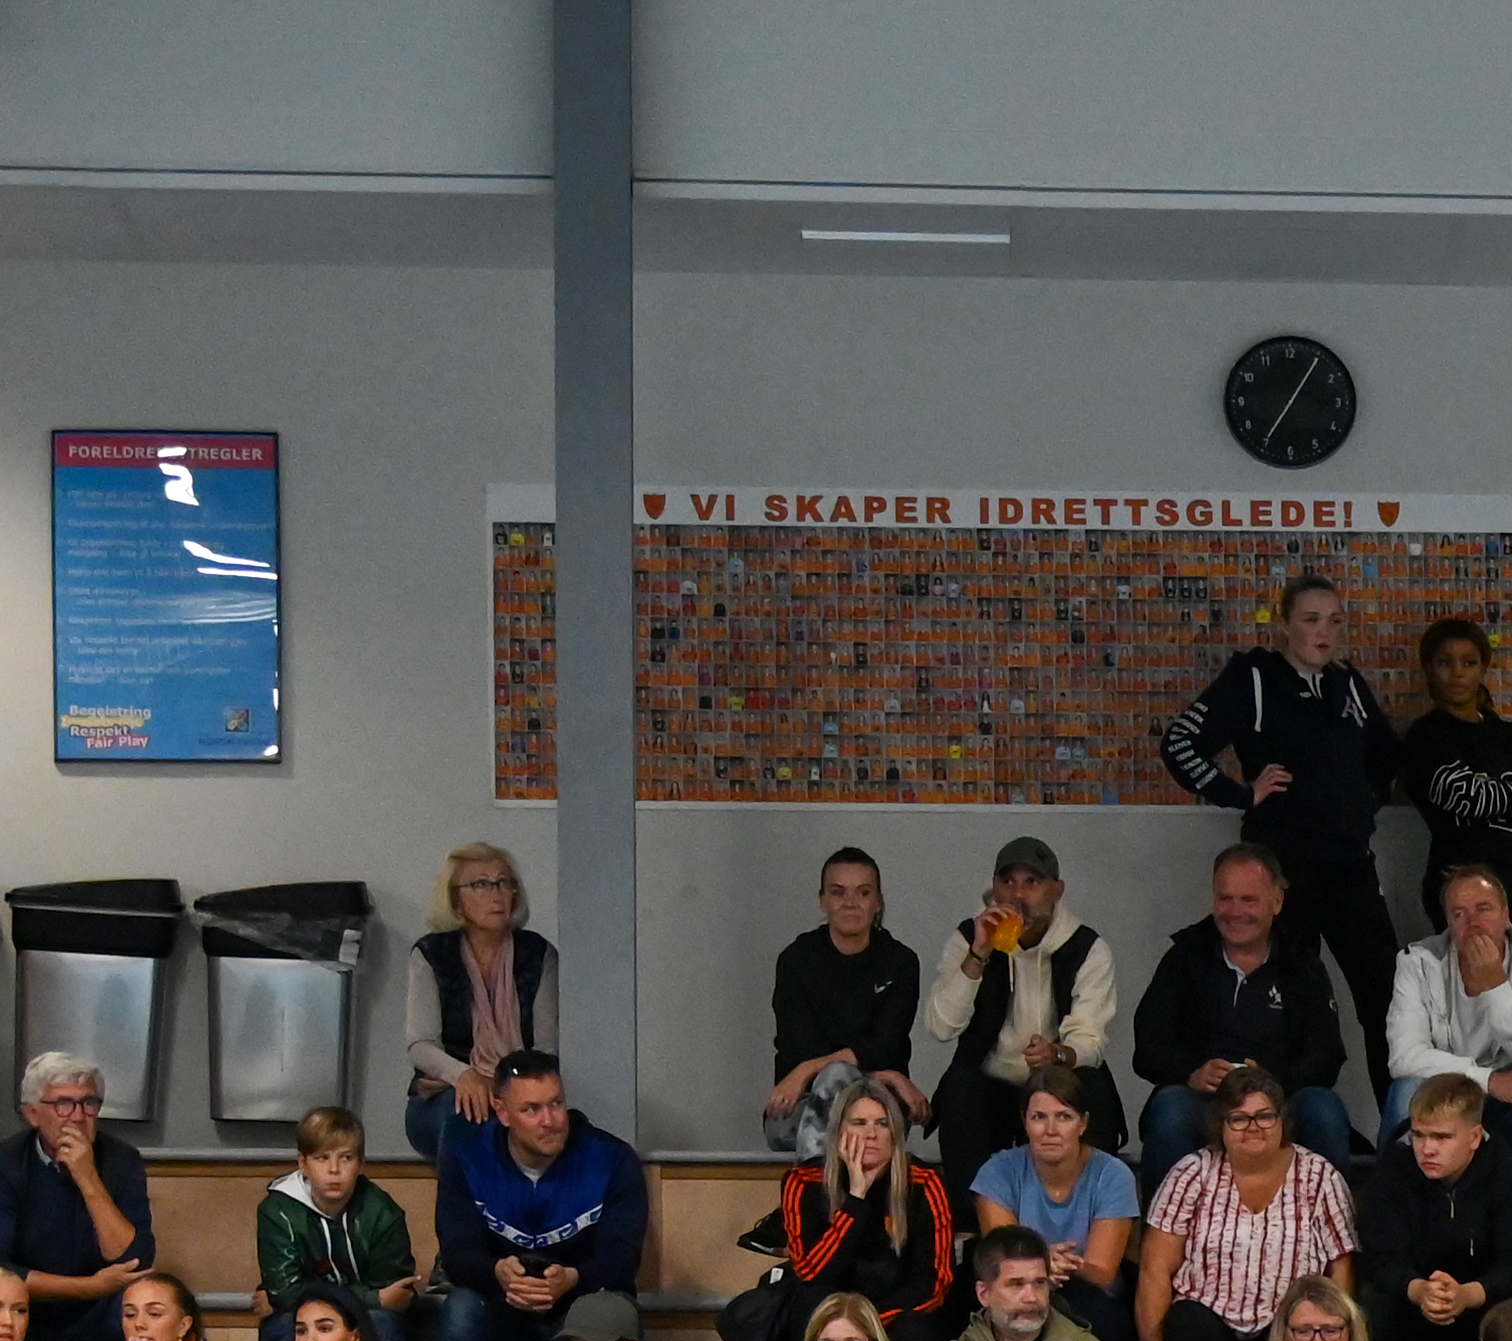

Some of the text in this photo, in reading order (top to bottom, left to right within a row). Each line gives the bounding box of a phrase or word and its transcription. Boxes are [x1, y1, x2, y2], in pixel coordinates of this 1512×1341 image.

[68, 444, 264, 461] FORELDRETREGLER
[690, 493, 1354, 529] VI SKAPER IDRETTSGLEDE!
[69, 704, 152, 721] Begeistring
[70, 724, 130, 738] Respekt
[86, 734, 149, 749] Fair Play
